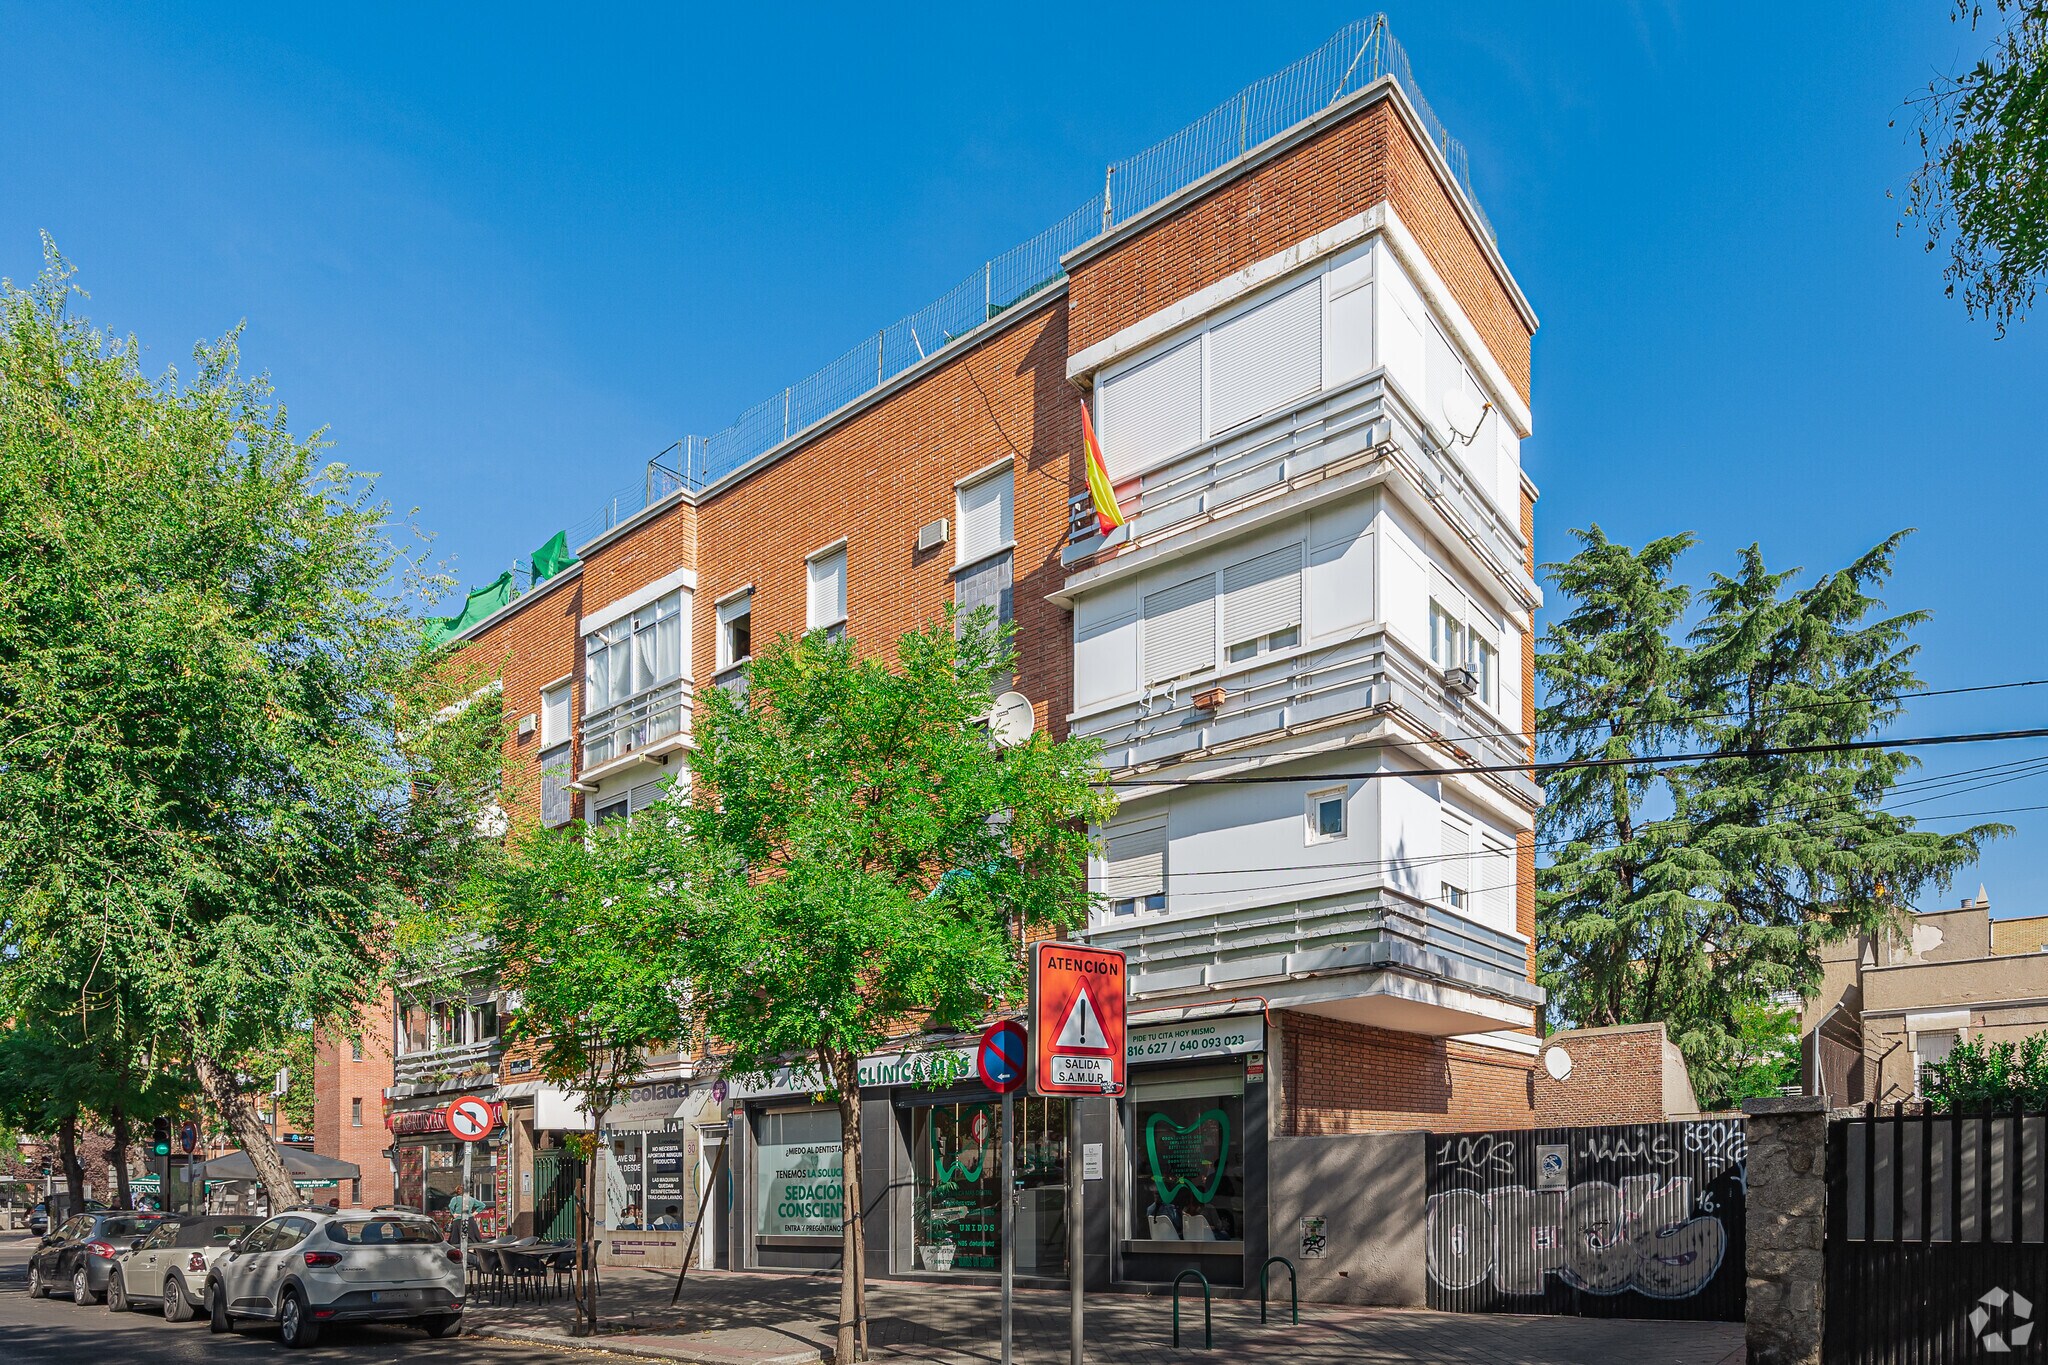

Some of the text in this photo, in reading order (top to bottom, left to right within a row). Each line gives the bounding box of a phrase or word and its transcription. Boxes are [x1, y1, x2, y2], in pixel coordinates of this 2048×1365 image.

[1048, 957, 1118, 976] ATENCIÓN
[1132, 1026, 1216, 1043] PIDE TU CITA HOY MISMO
[1127, 1045, 1144, 1057] 816
[1147, 1042, 1168, 1055] 627
[1179, 1039, 1199, 1052] 640
[1201, 1037, 1221, 1049] 093
[1223, 1034, 1245, 1047] 023
[1065, 1059, 1100, 1070] SALIDA
[857, 1060, 925, 1086] CLÍNICA
[631, 1082, 690, 1103] colada
[687, 1143, 696, 1154] 30
[785, 1147, 806, 1157] ¿MIEDO
[806, 1146, 815, 1154] AL
[629, 1154, 637, 1162] SU
[775, 1167, 844, 1179] TENEMOS LA SOLUCI
[129, 1184, 161, 1194] PRENSA
[785, 1179, 844, 1201] SEDACIÓN
[778, 1203, 844, 1218] CONSCIENT
[784, 1224, 801, 1232] ENTRA
[959, 1224, 995, 1232] UNIDOS
